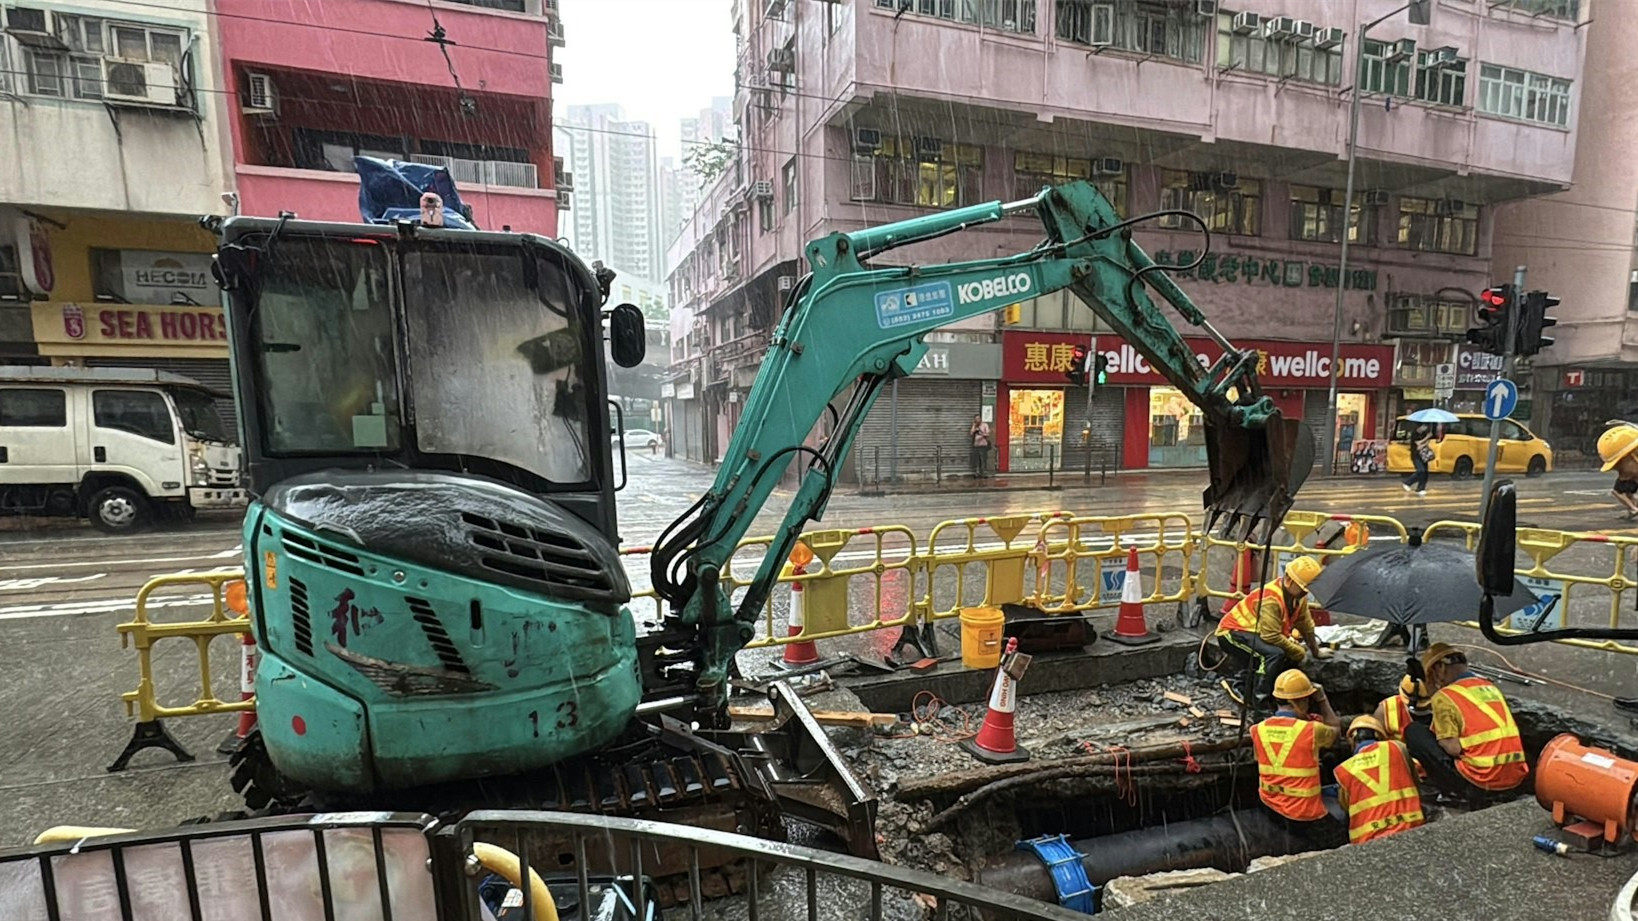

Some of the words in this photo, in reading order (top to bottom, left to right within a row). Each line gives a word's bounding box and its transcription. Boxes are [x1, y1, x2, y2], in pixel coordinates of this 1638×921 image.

[957, 273, 1031, 304] KOBELCO
[99, 310, 153, 339] SEA
[1024, 342, 1075, 372] 惠康
[1271, 351, 1380, 378] wellcome
